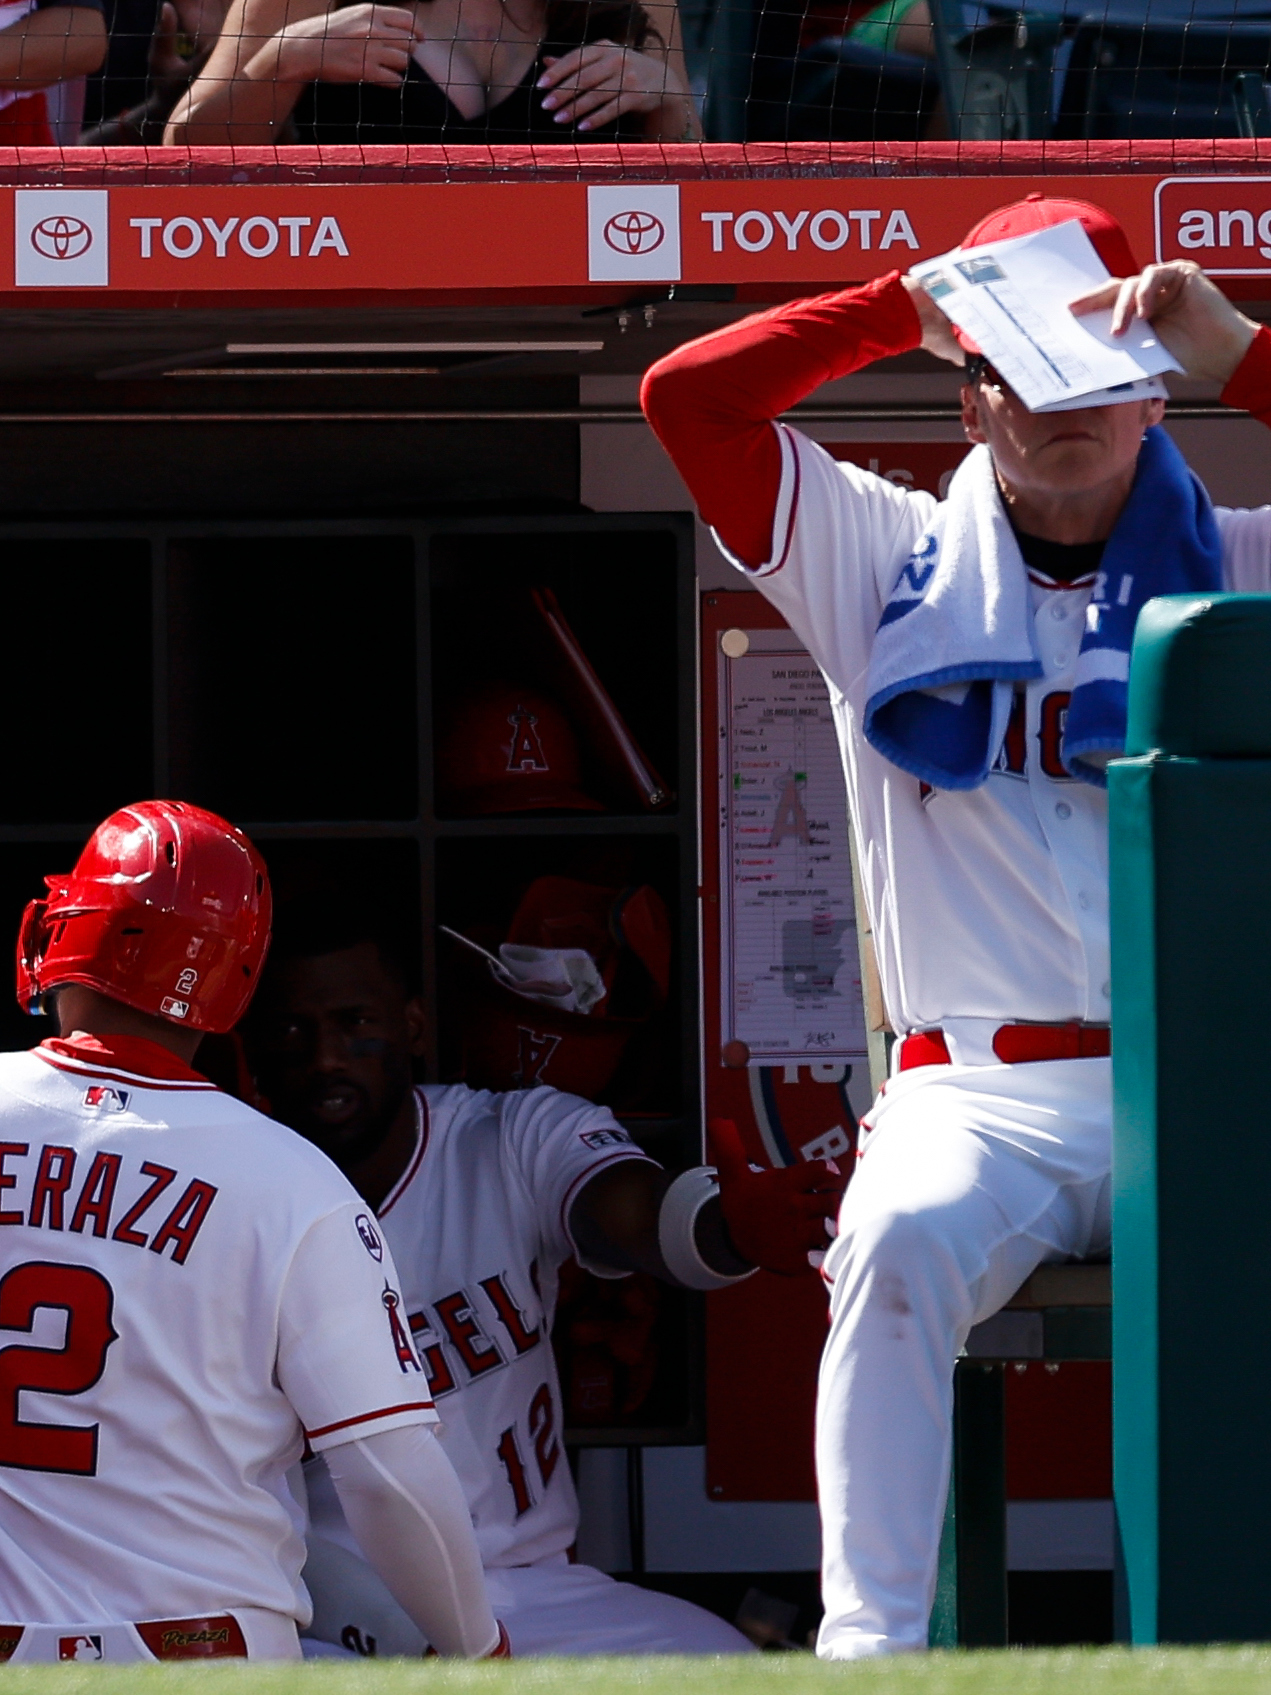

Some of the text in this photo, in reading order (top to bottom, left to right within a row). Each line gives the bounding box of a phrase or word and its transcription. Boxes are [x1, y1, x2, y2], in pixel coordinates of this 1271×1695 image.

[130, 216, 349, 259] TOYOTA
[701, 209, 919, 253] TOYOTA
[507, 707, 550, 772] A
[175, 967, 198, 995] 2
[381, 1278, 422, 1374] A
[497, 1382, 560, 1518] 12
[161, 1628, 230, 1650] PERAZA
